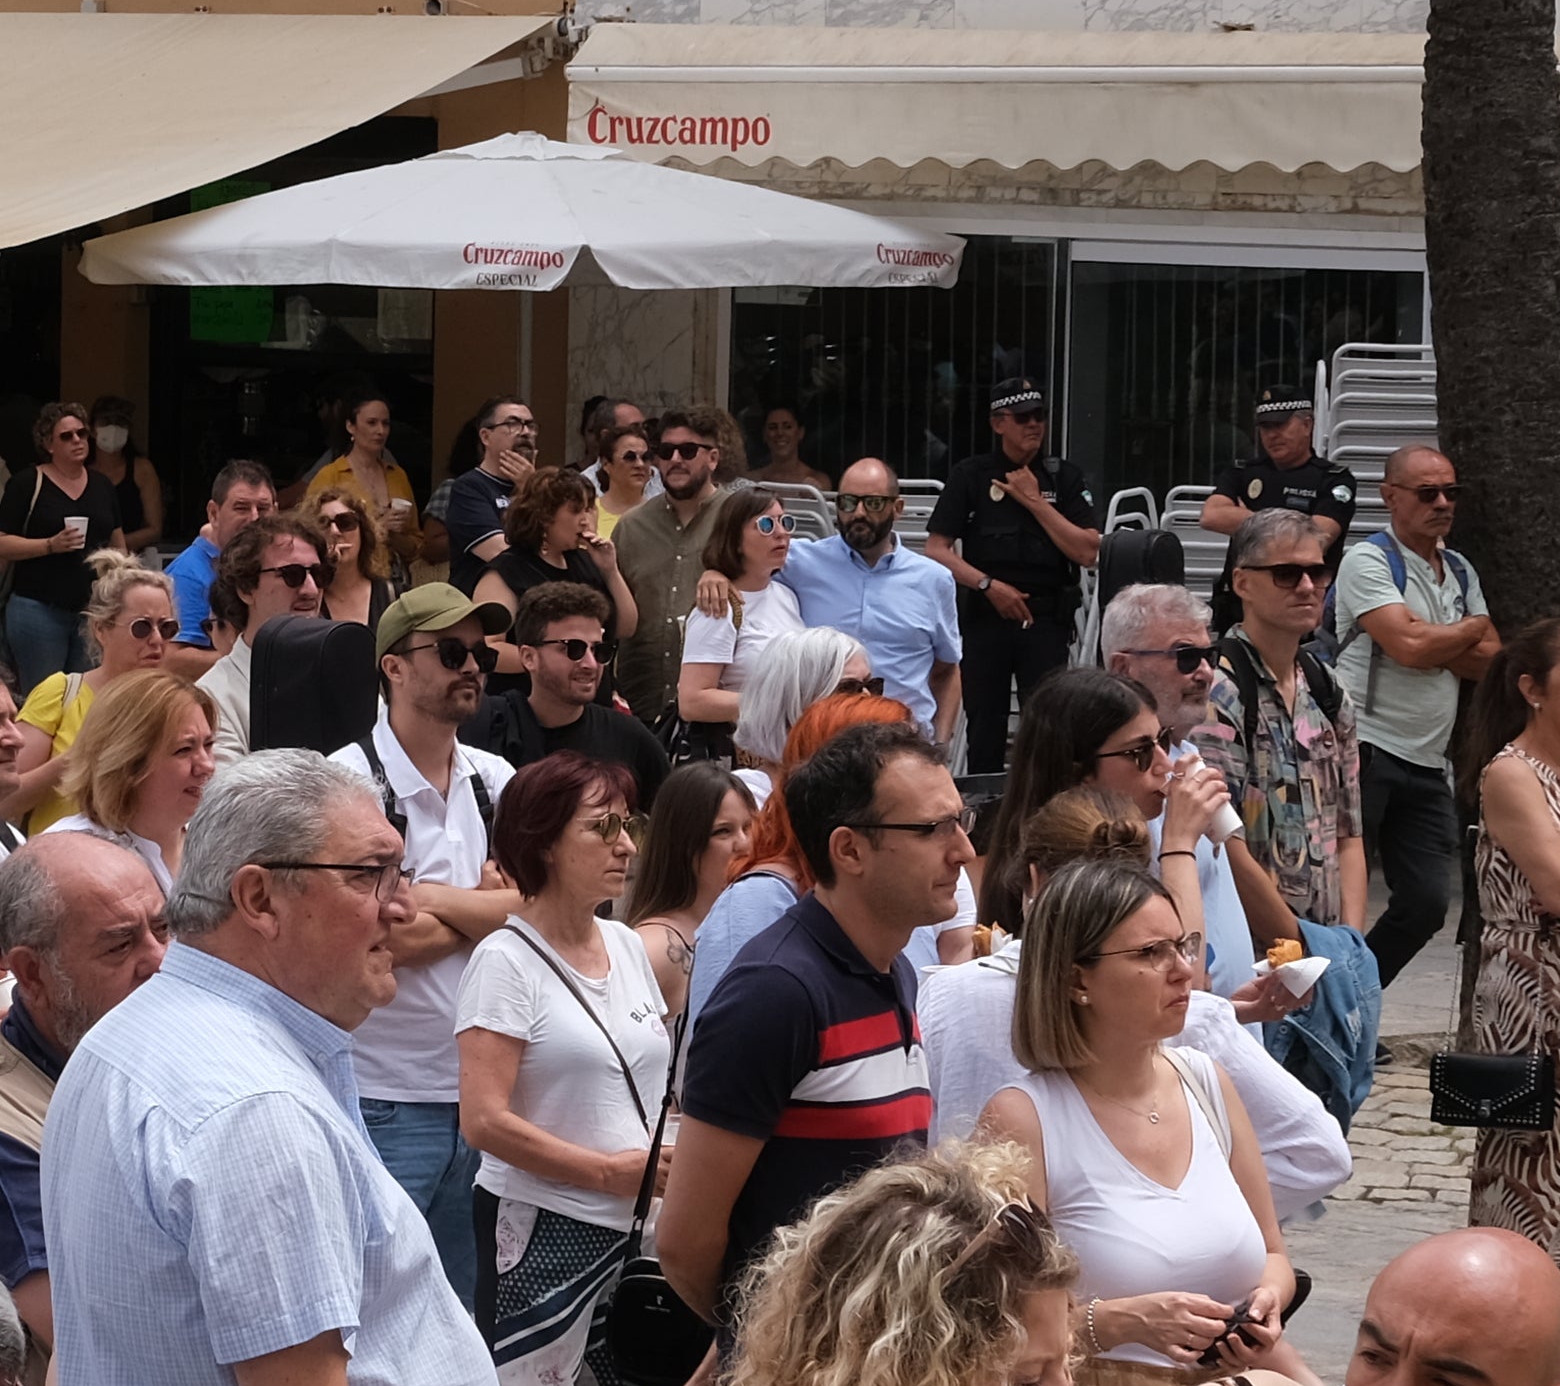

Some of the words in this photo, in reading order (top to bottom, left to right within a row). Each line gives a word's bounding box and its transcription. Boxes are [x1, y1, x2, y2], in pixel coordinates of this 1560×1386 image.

[587, 104, 771, 152] Cruzcampo
[463, 242, 565, 271] Cruzcampo
[876, 242, 955, 269] Cruzcampo
[476, 272, 538, 287] ESPECIAL
